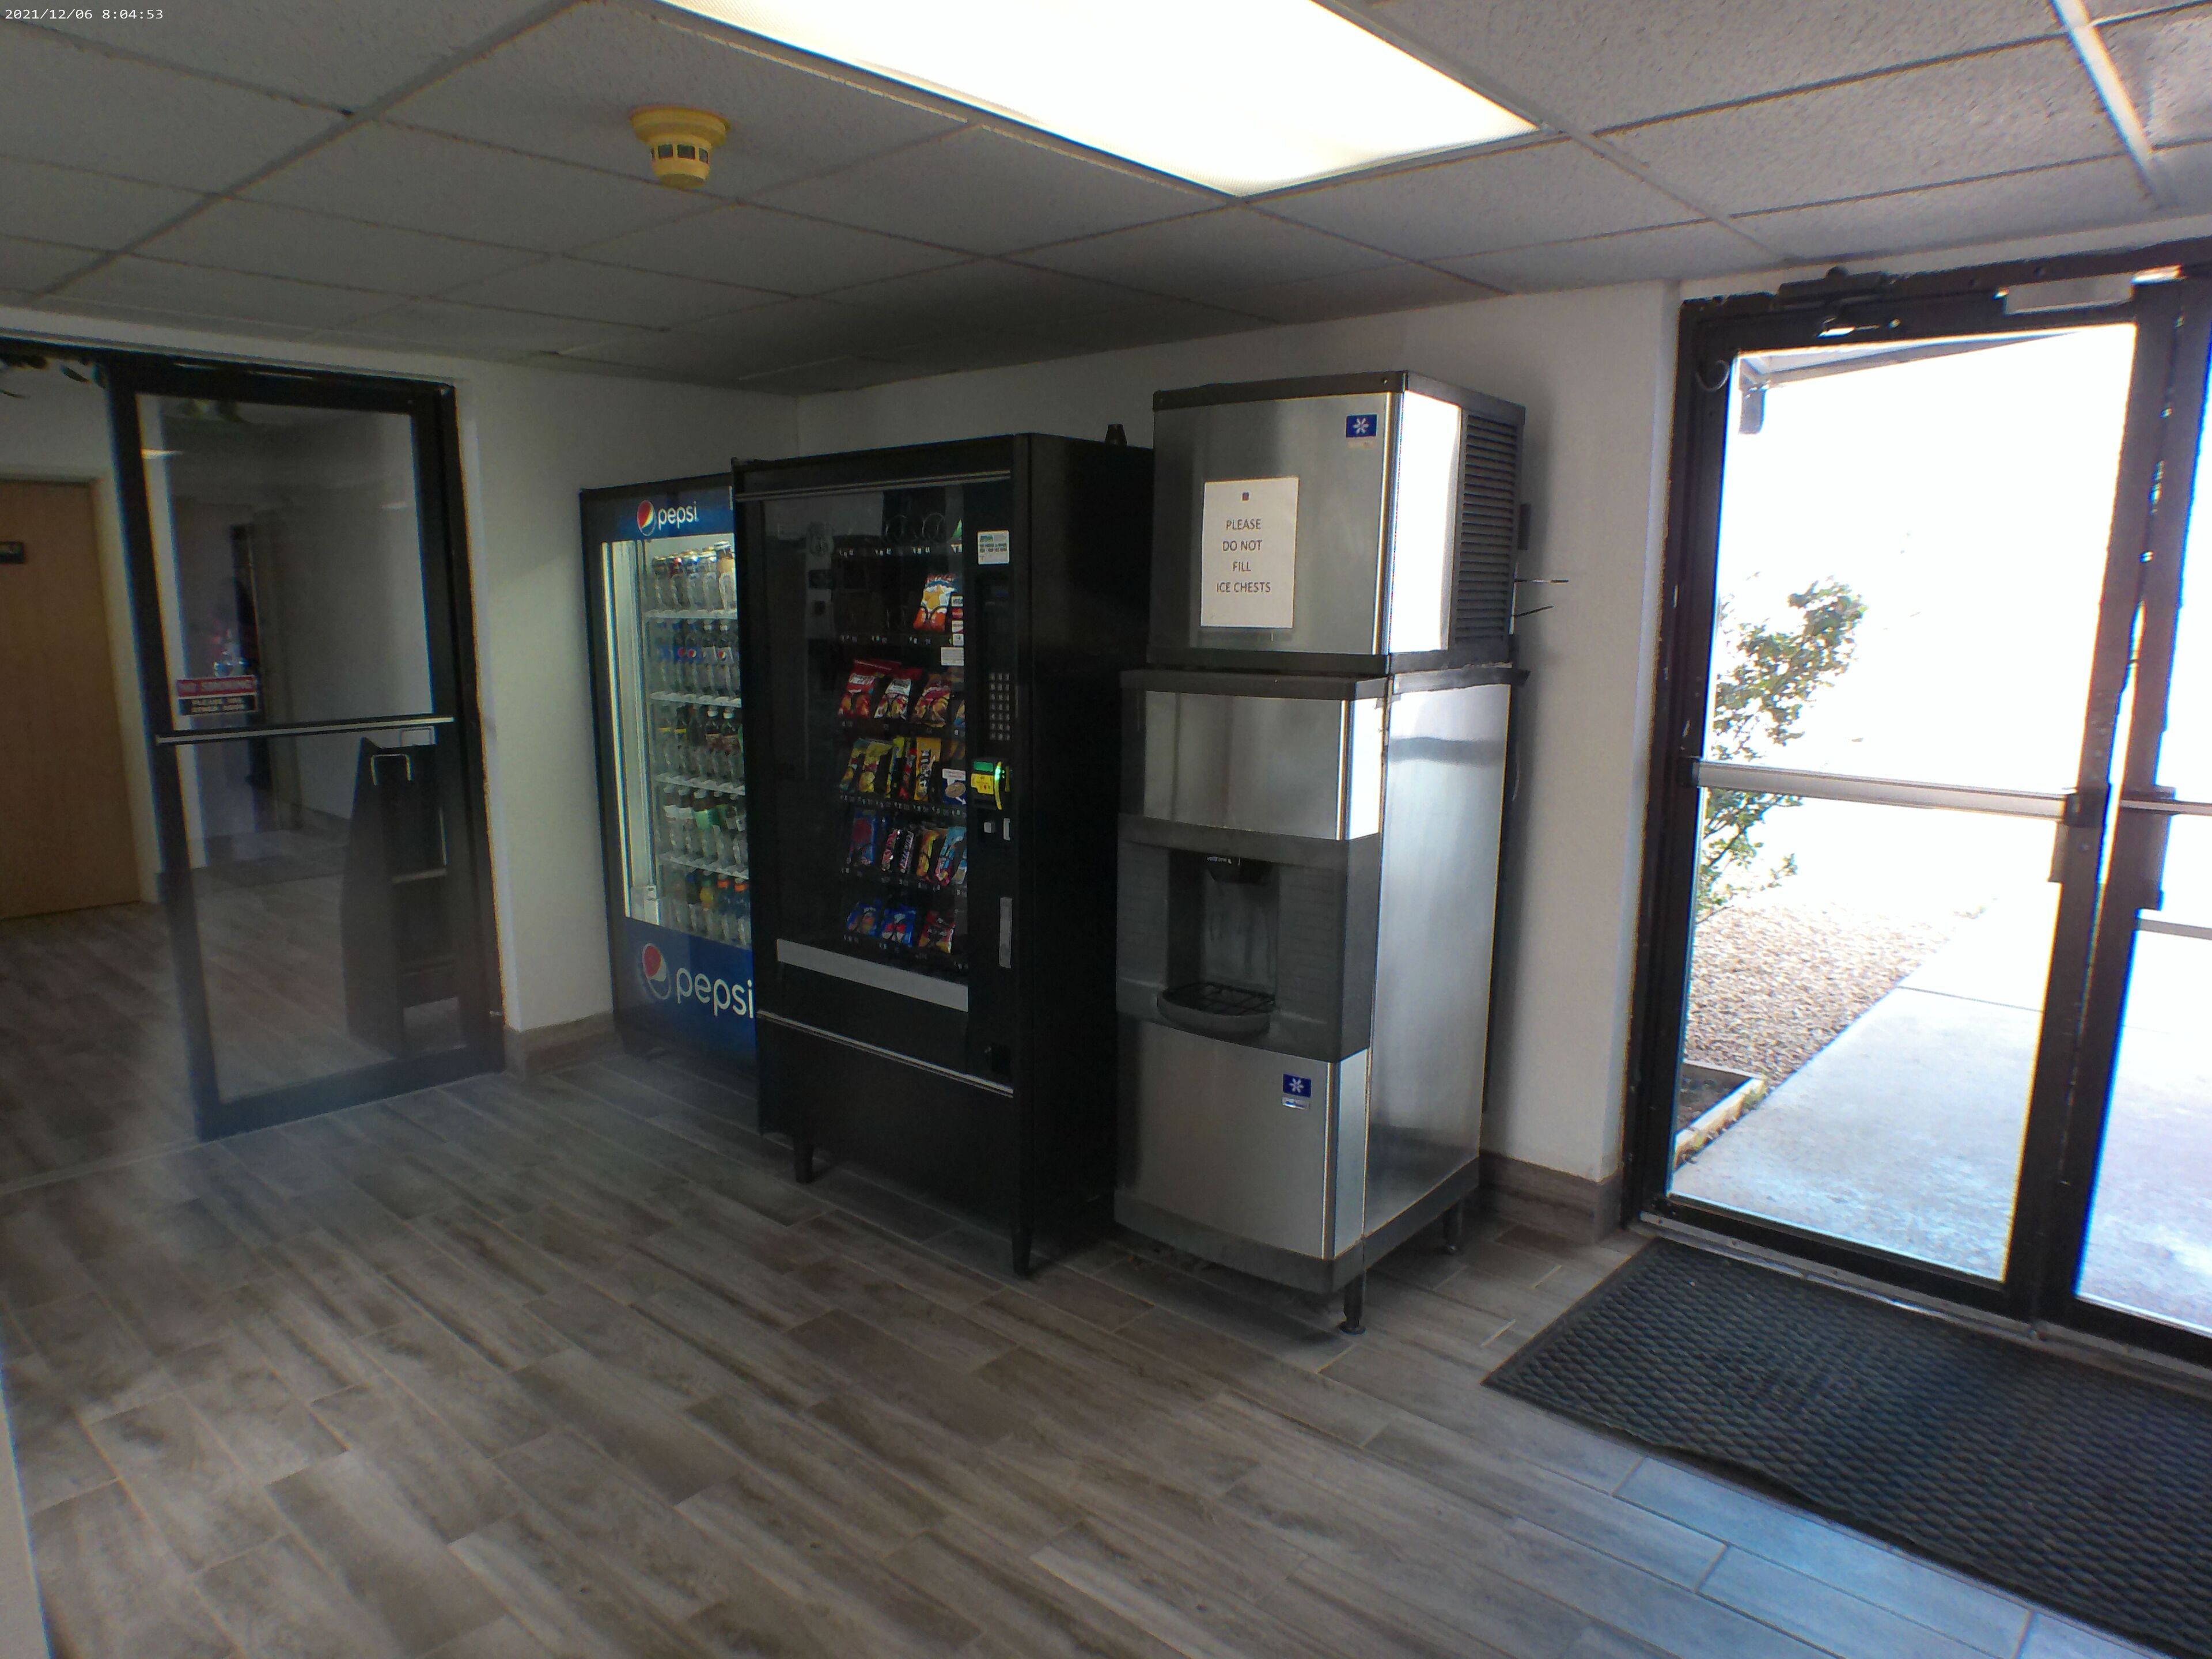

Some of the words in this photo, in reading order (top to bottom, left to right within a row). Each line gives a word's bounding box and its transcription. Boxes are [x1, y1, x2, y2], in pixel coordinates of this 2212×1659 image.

[657, 500, 698, 530] pepsi
[1226, 518, 1262, 531] PLEASE
[1222, 540, 1237, 552] DO
[1240, 539, 1263, 551] NOT
[1232, 561, 1251, 572] FILL
[1217, 582, 1231, 593] ICE
[1234, 581, 1271, 593] CHESTS
[676, 967, 755, 1019] pepsi
